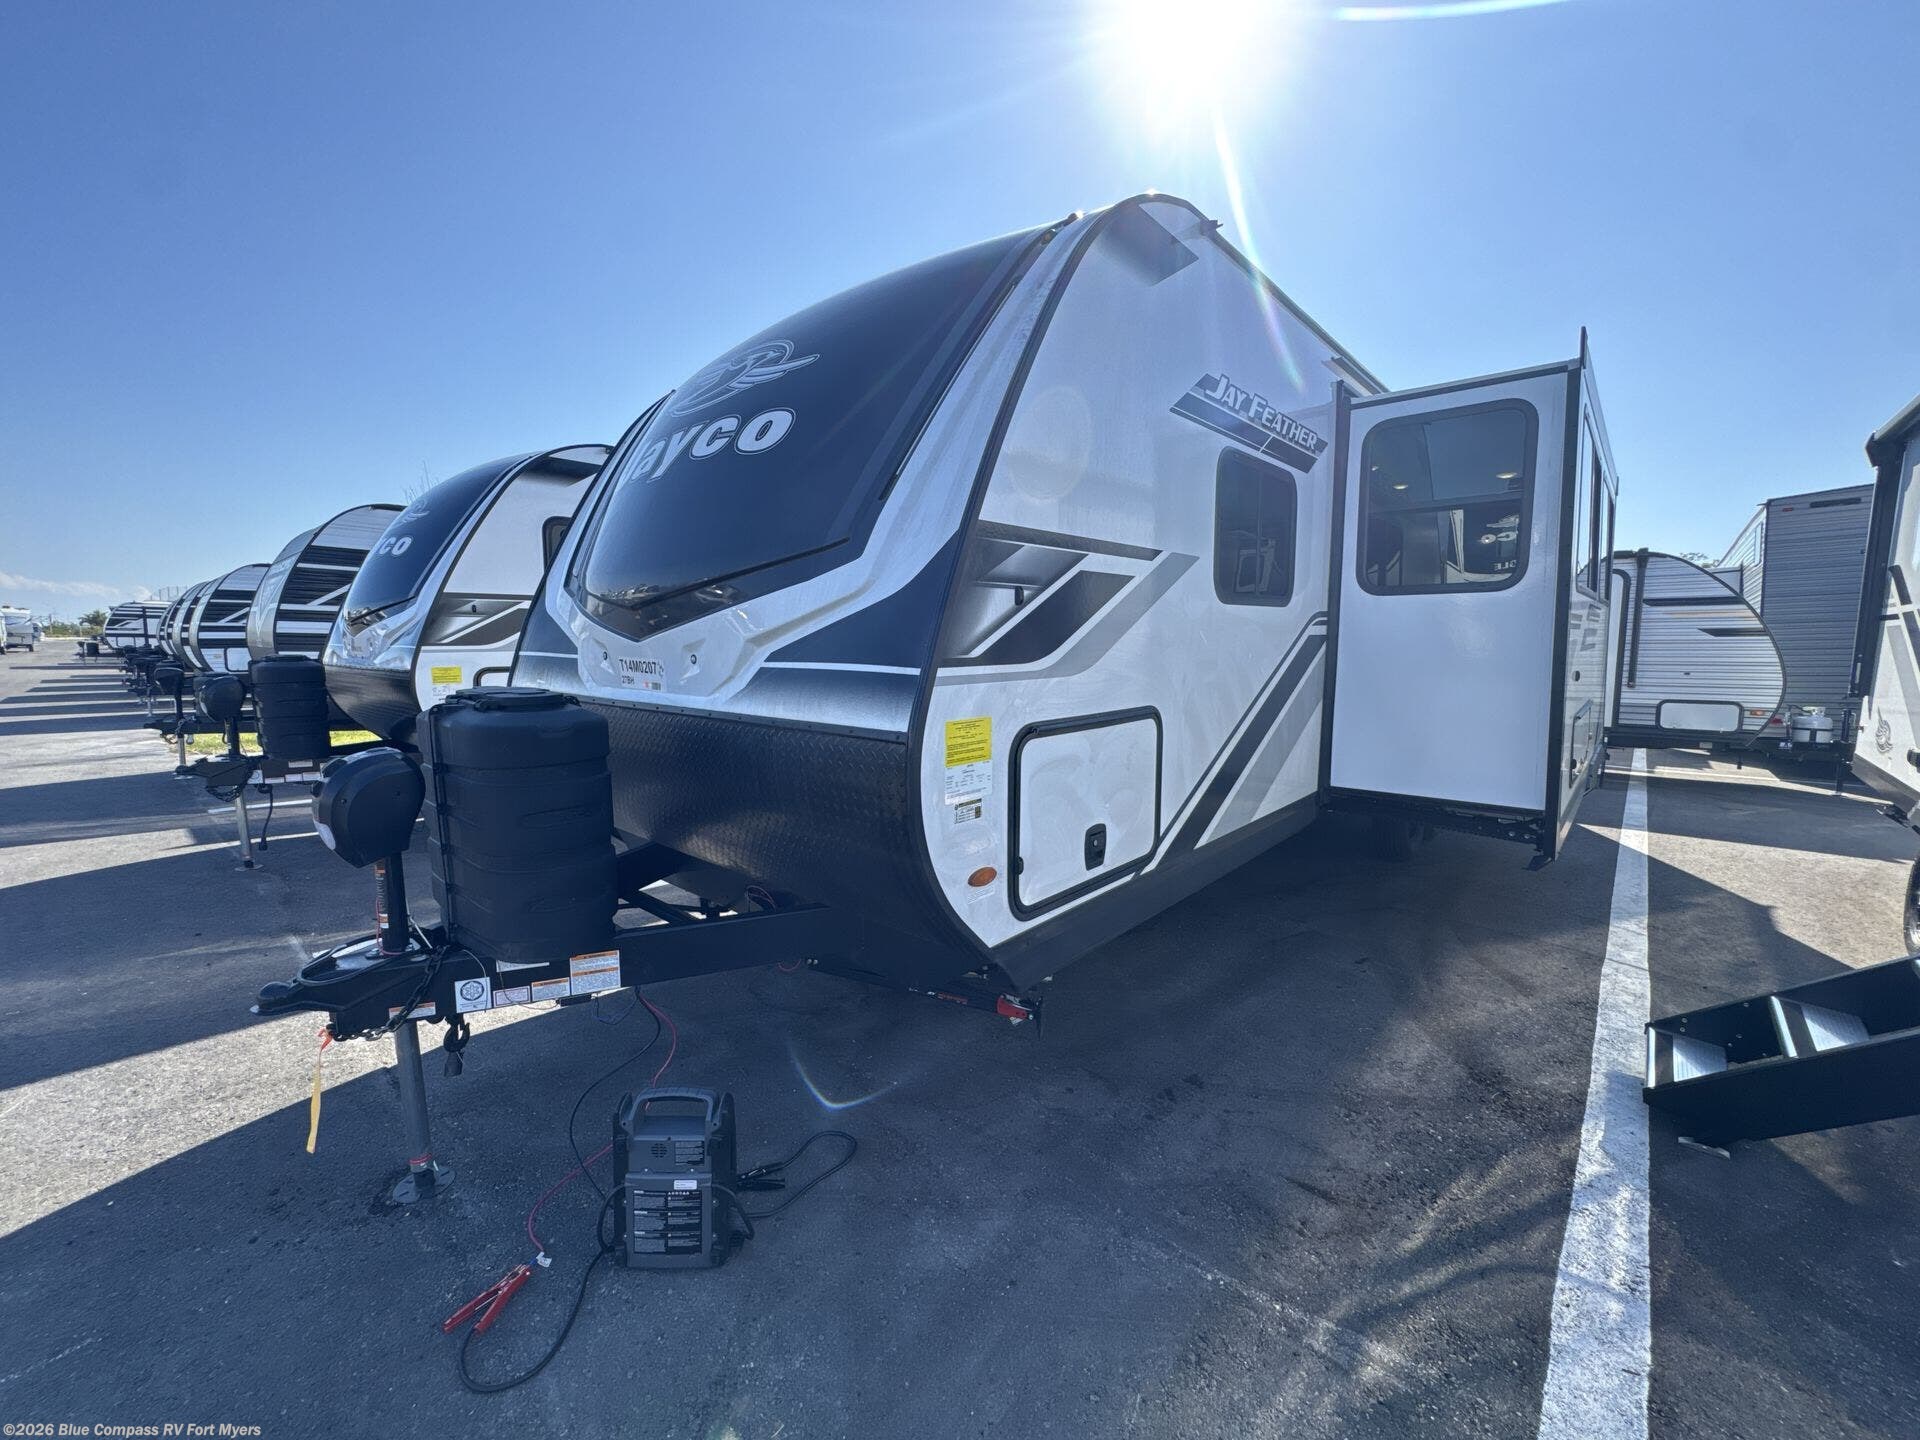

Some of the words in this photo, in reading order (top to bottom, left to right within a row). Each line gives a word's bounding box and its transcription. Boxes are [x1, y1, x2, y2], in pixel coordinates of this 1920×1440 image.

[1205, 374, 1249, 411] JAY
[1248, 393, 1318, 450] FEATHER
[618, 658, 657, 675] T14M0207
